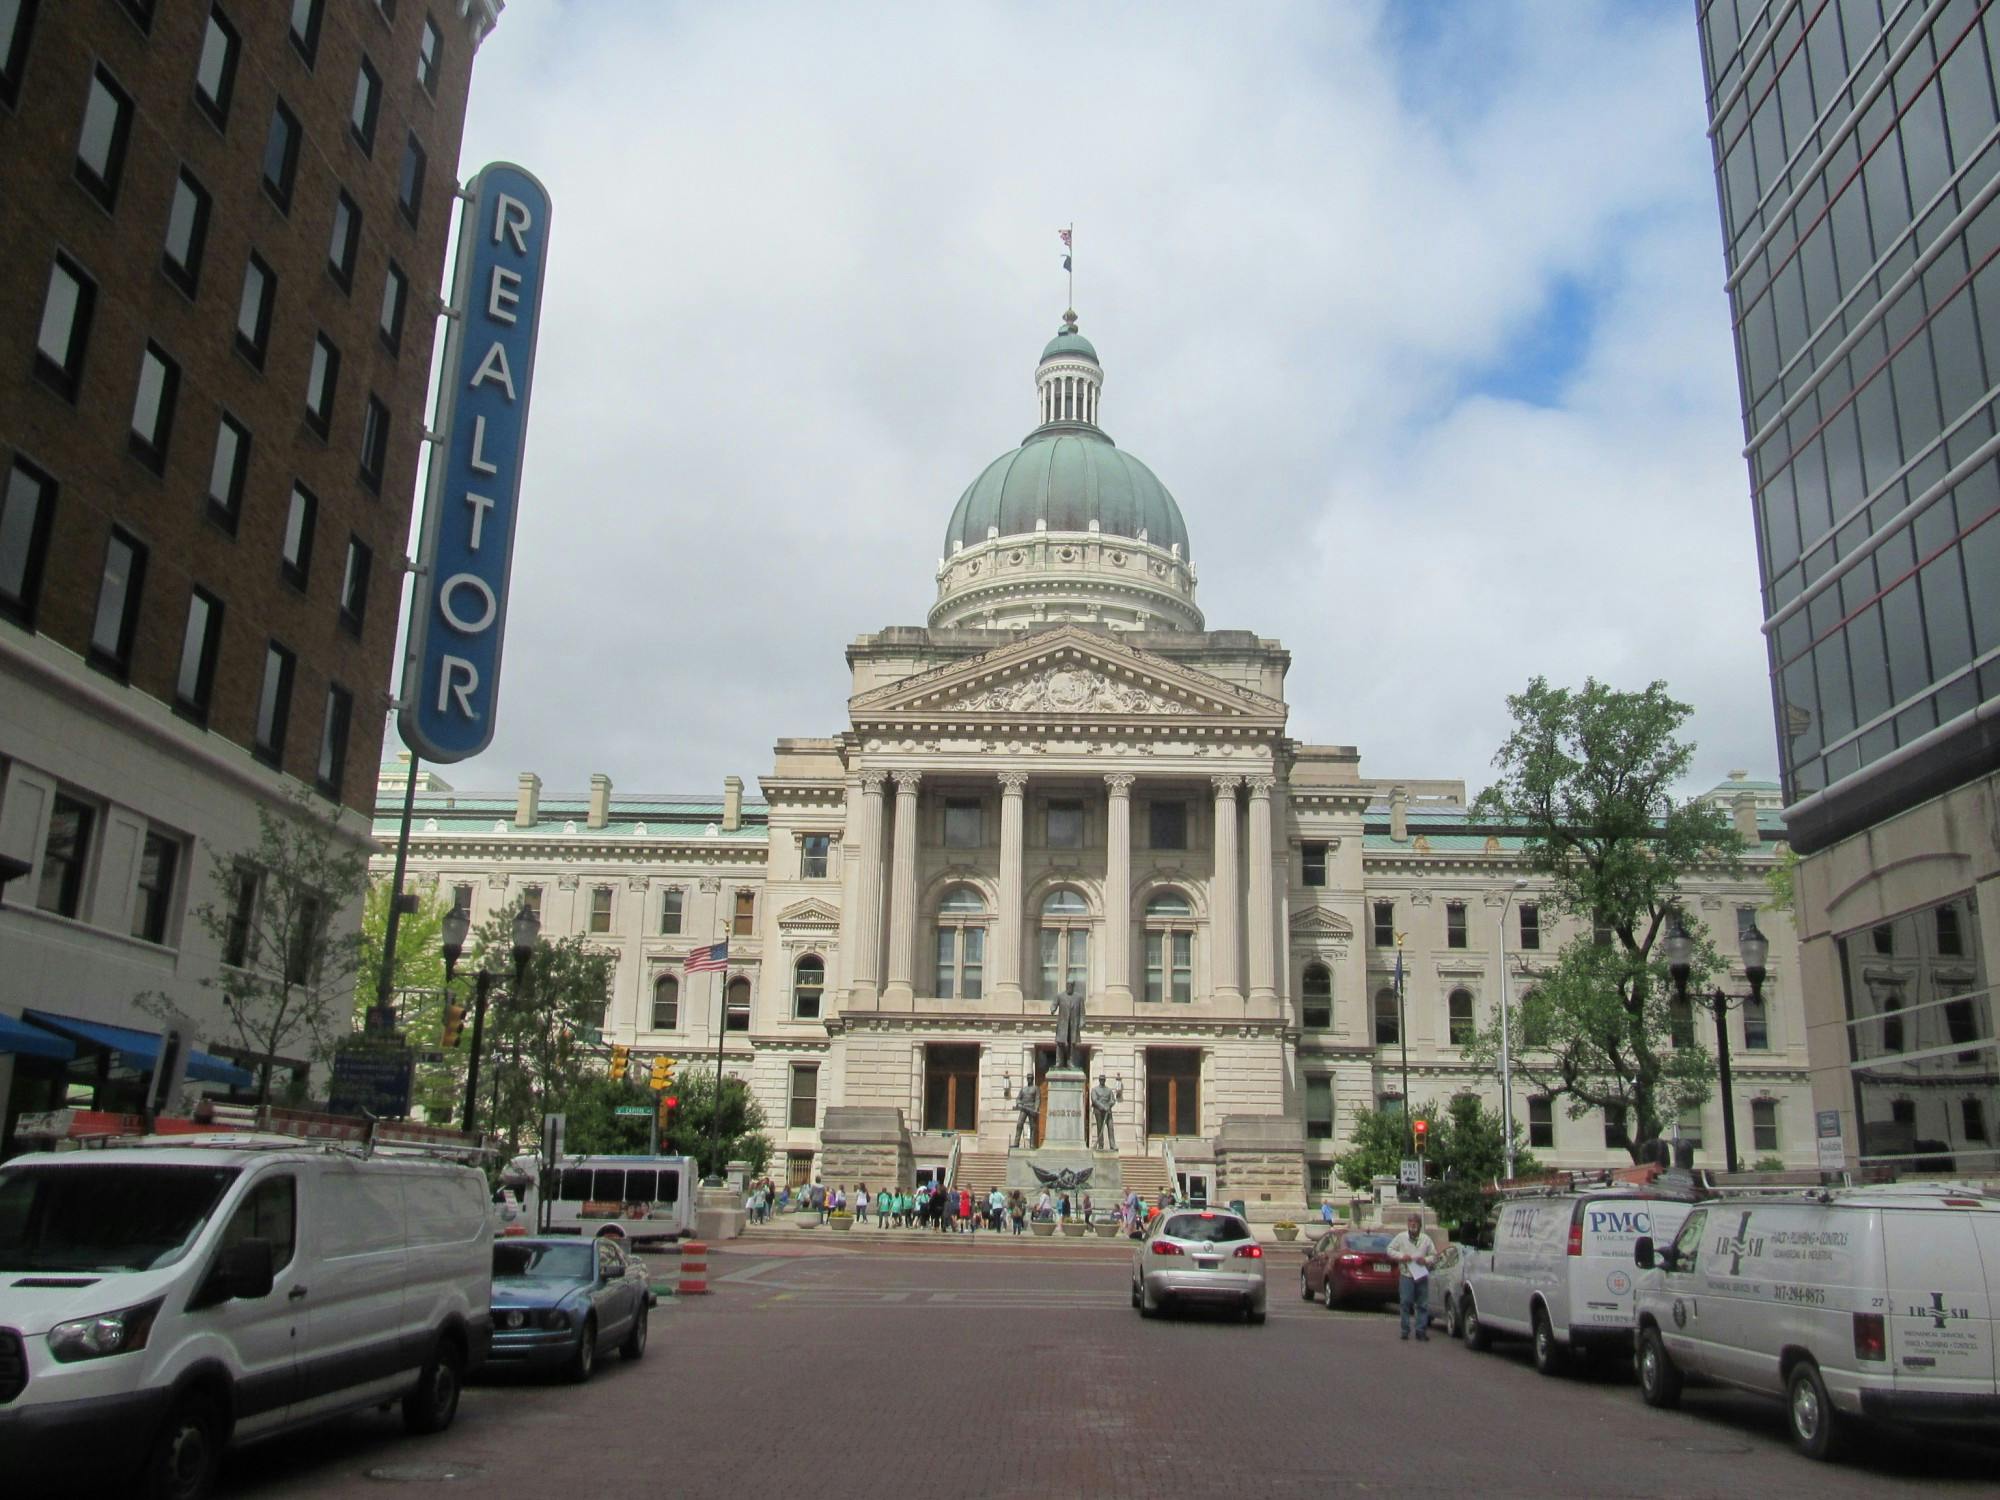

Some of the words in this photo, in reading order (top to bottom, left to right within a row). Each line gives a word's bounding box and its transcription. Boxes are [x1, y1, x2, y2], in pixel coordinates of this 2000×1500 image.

[1402, 1161, 1417, 1169] ONE
[1402, 1169, 1417, 1177] WAY
[1589, 1211, 1651, 1233] PMC
[1872, 1298, 1884, 1307] 27
